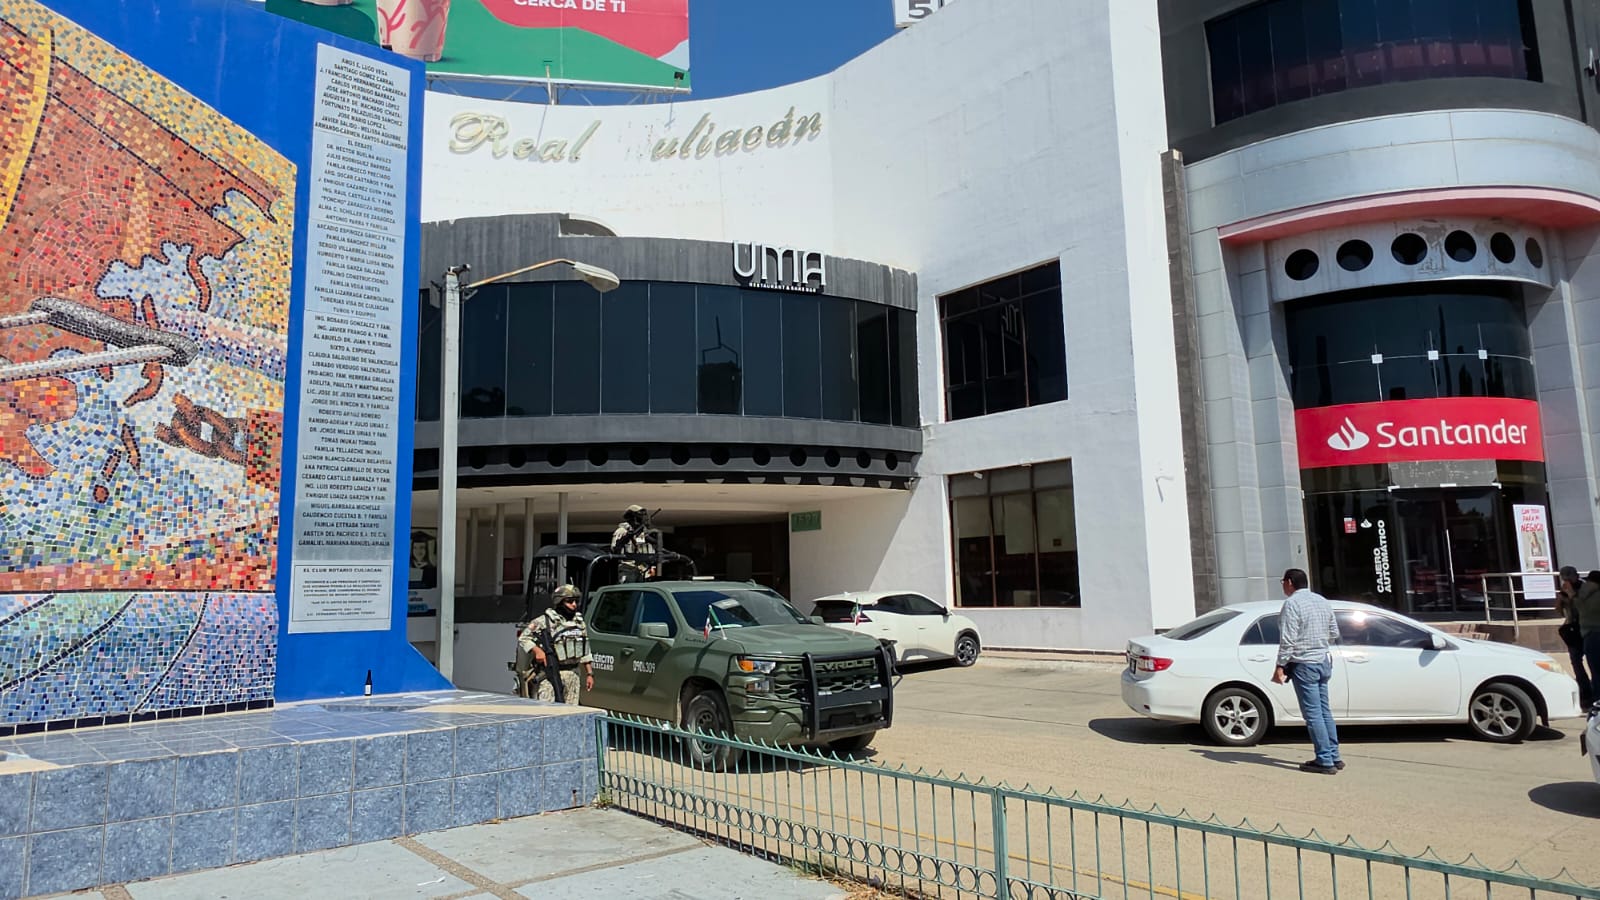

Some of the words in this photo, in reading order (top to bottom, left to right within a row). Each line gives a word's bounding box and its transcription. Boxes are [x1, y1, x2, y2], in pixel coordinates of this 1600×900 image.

[582, 0, 606, 11] DE
[609, 0, 626, 13] TI
[449, 112, 601, 162] Real
[733, 240, 826, 286] UMA
[1376, 418, 1528, 449] Santander
[1373, 548, 1385, 593] CAJERO
[1377, 519, 1392, 593] AUTOMÁTICO
[593, 652, 614, 665] JÉRCITO
